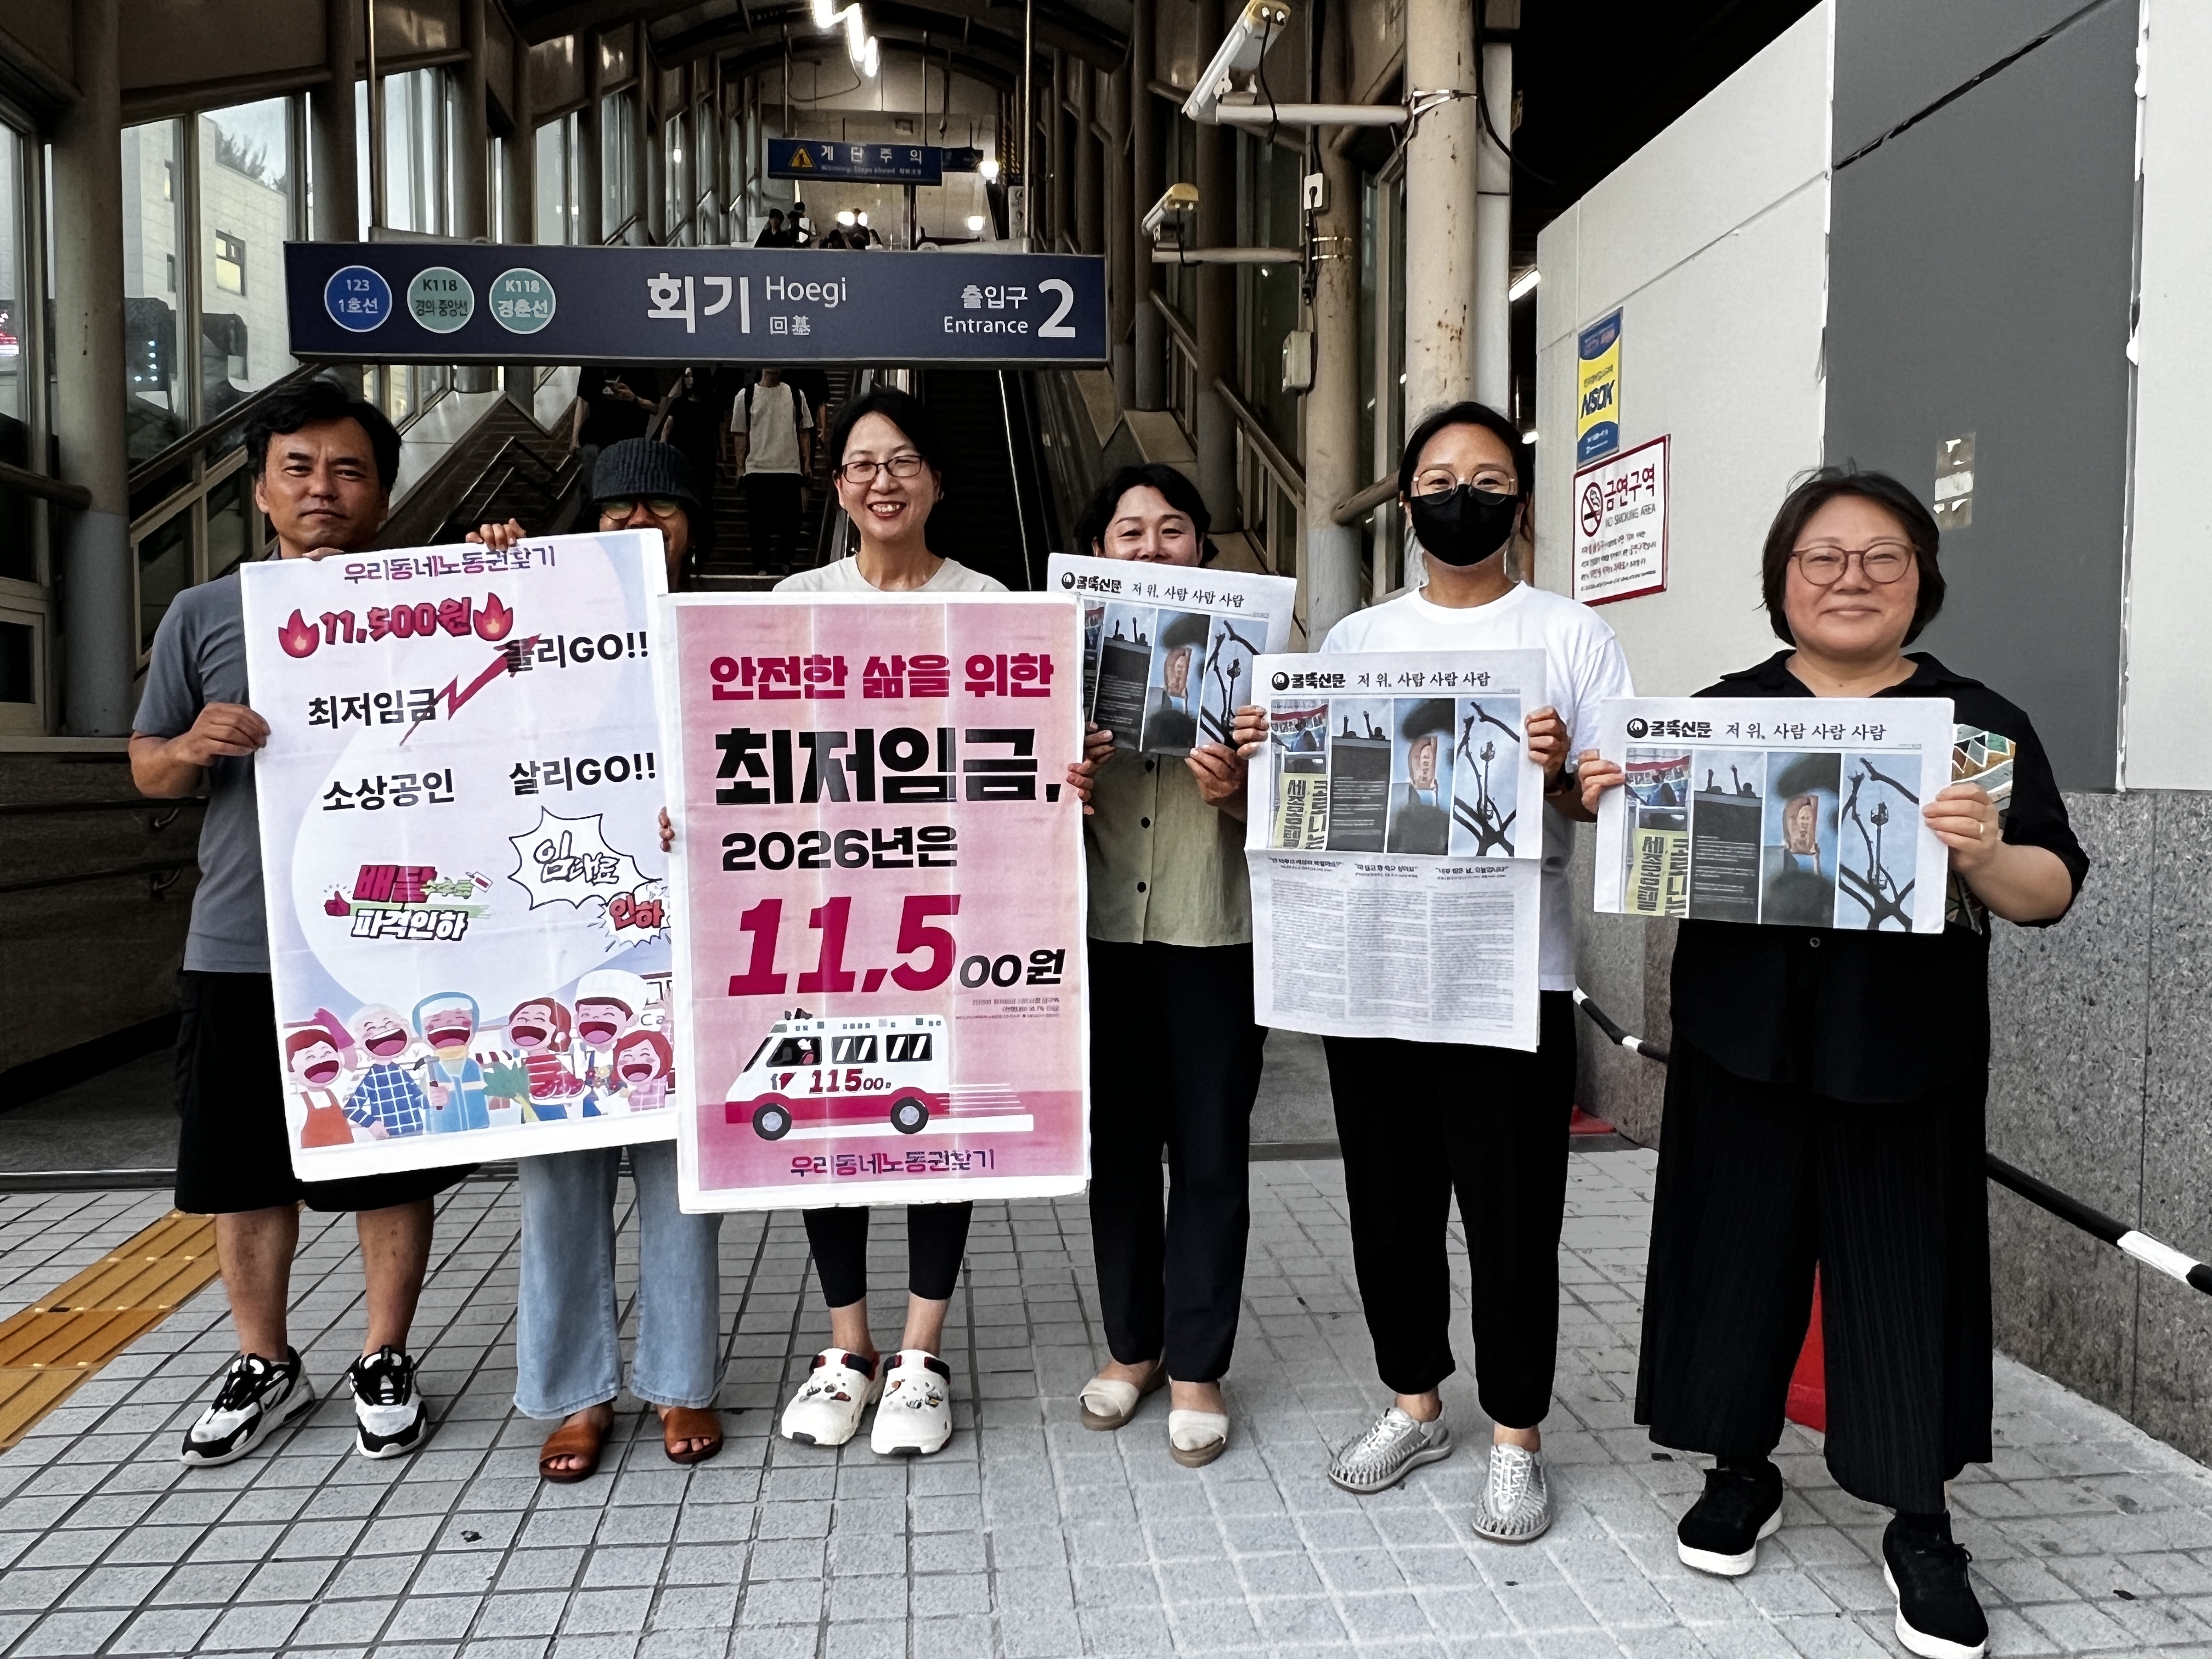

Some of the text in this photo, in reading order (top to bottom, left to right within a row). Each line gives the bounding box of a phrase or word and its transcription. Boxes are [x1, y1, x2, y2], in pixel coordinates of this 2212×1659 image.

[346, 279, 370, 291] 123
[423, 279, 457, 292] K118
[506, 280, 539, 293] K118
[766, 276, 847, 308] Hoegi
[961, 285, 1028, 310] 출입구
[338, 298, 378, 314] 1호선
[498, 300, 548, 318] 경춘선
[647, 273, 751, 334] 회기
[1038, 279, 1076, 338] 2
[770, 315, 811, 336] 回基
[944, 317, 1028, 334] Entrance
[1604, 464, 1655, 511] 금연구역
[344, 546, 556, 584] 우리동네노동권찾기
[710, 653, 1054, 700] 안전한 삶을 위한
[1291, 672, 1346, 689] 굴뚝신문
[1398, 672, 1425, 687] 사람
[1430, 672, 1458, 687] 사람
[1463, 672, 1491, 687] 사람
[308, 688, 437, 729] 최저임금
[1650, 719, 1713, 738] 굴뚝신문
[1725, 723, 1740, 738] 저
[1774, 723, 1807, 740] 사람
[1812, 724, 1847, 741] 사람
[1852, 724, 1887, 741] 사람
[323, 752, 656, 811] 소상공인 살리GO!!
[715, 727, 1060, 805] 최저임금,
[533, 830, 620, 886] 임대료
[722, 826, 957, 871] 2026년은
[351, 909, 469, 941] 파격인하
[609, 895, 664, 931] 인하
[728, 894, 1065, 996] 11,500원
[791, 1149, 994, 1177] 우리동네노동권찾기
